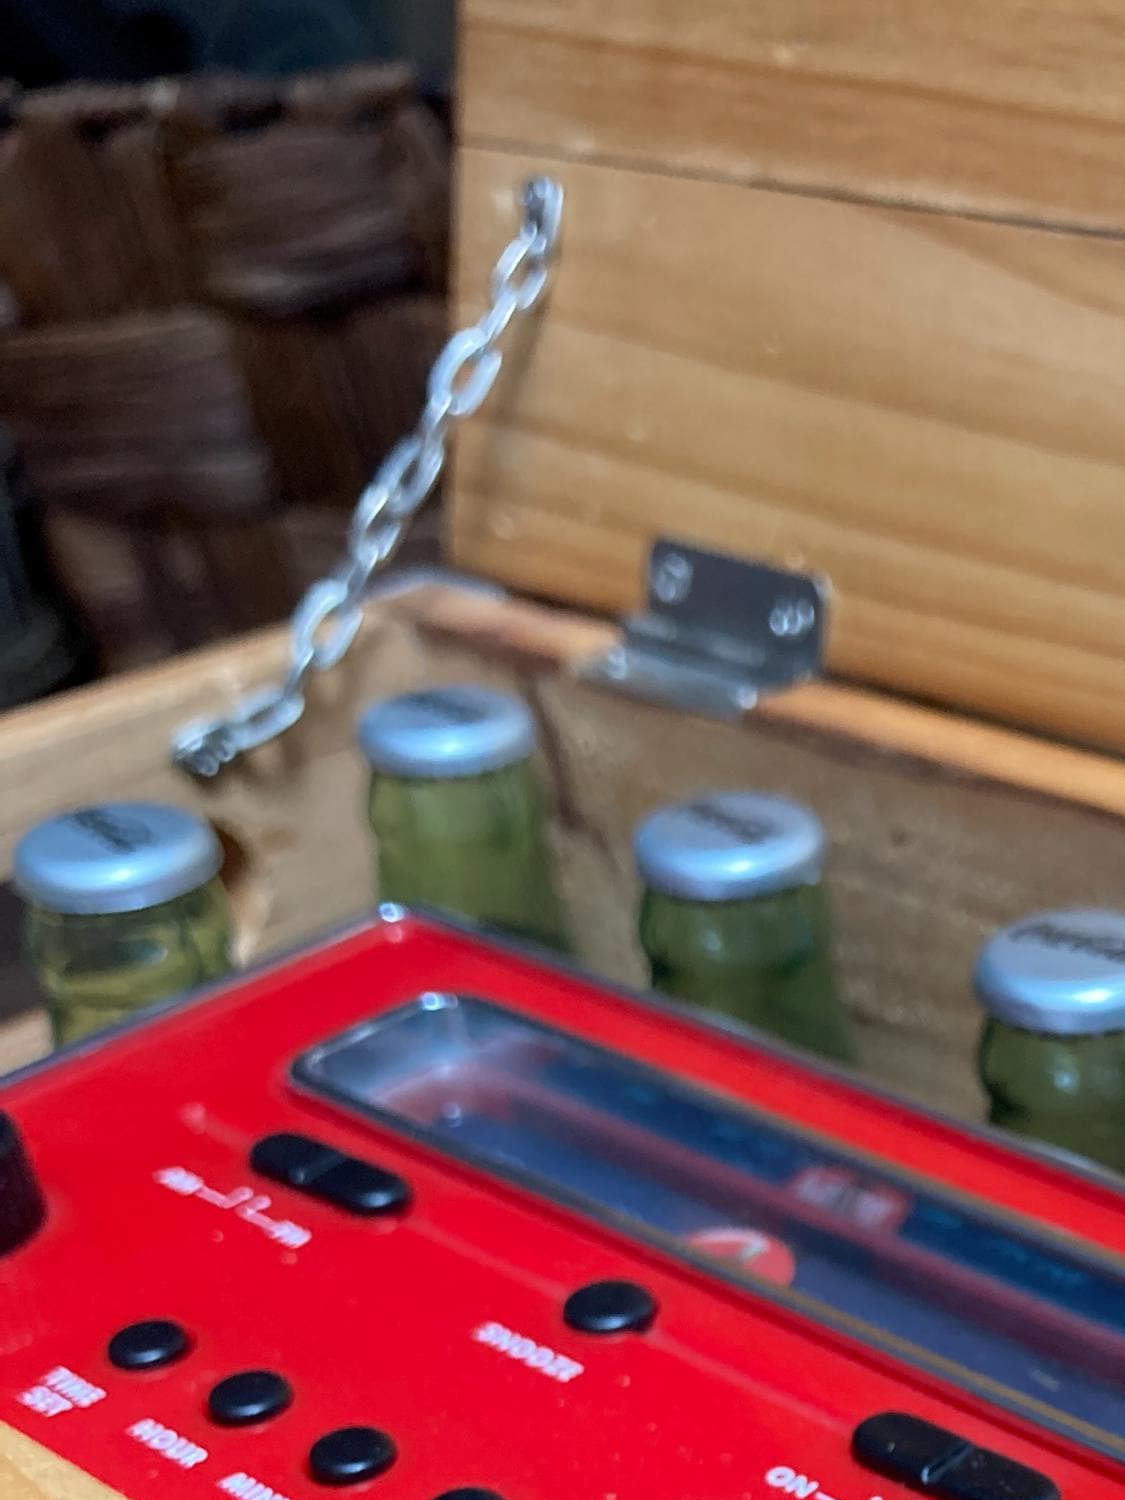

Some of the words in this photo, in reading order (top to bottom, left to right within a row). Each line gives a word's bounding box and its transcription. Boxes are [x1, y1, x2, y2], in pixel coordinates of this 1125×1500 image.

[474, 1321, 584, 1383] SNOOZE
[127, 1418, 209, 1469] HOUR
[766, 1466, 819, 1499] ON
